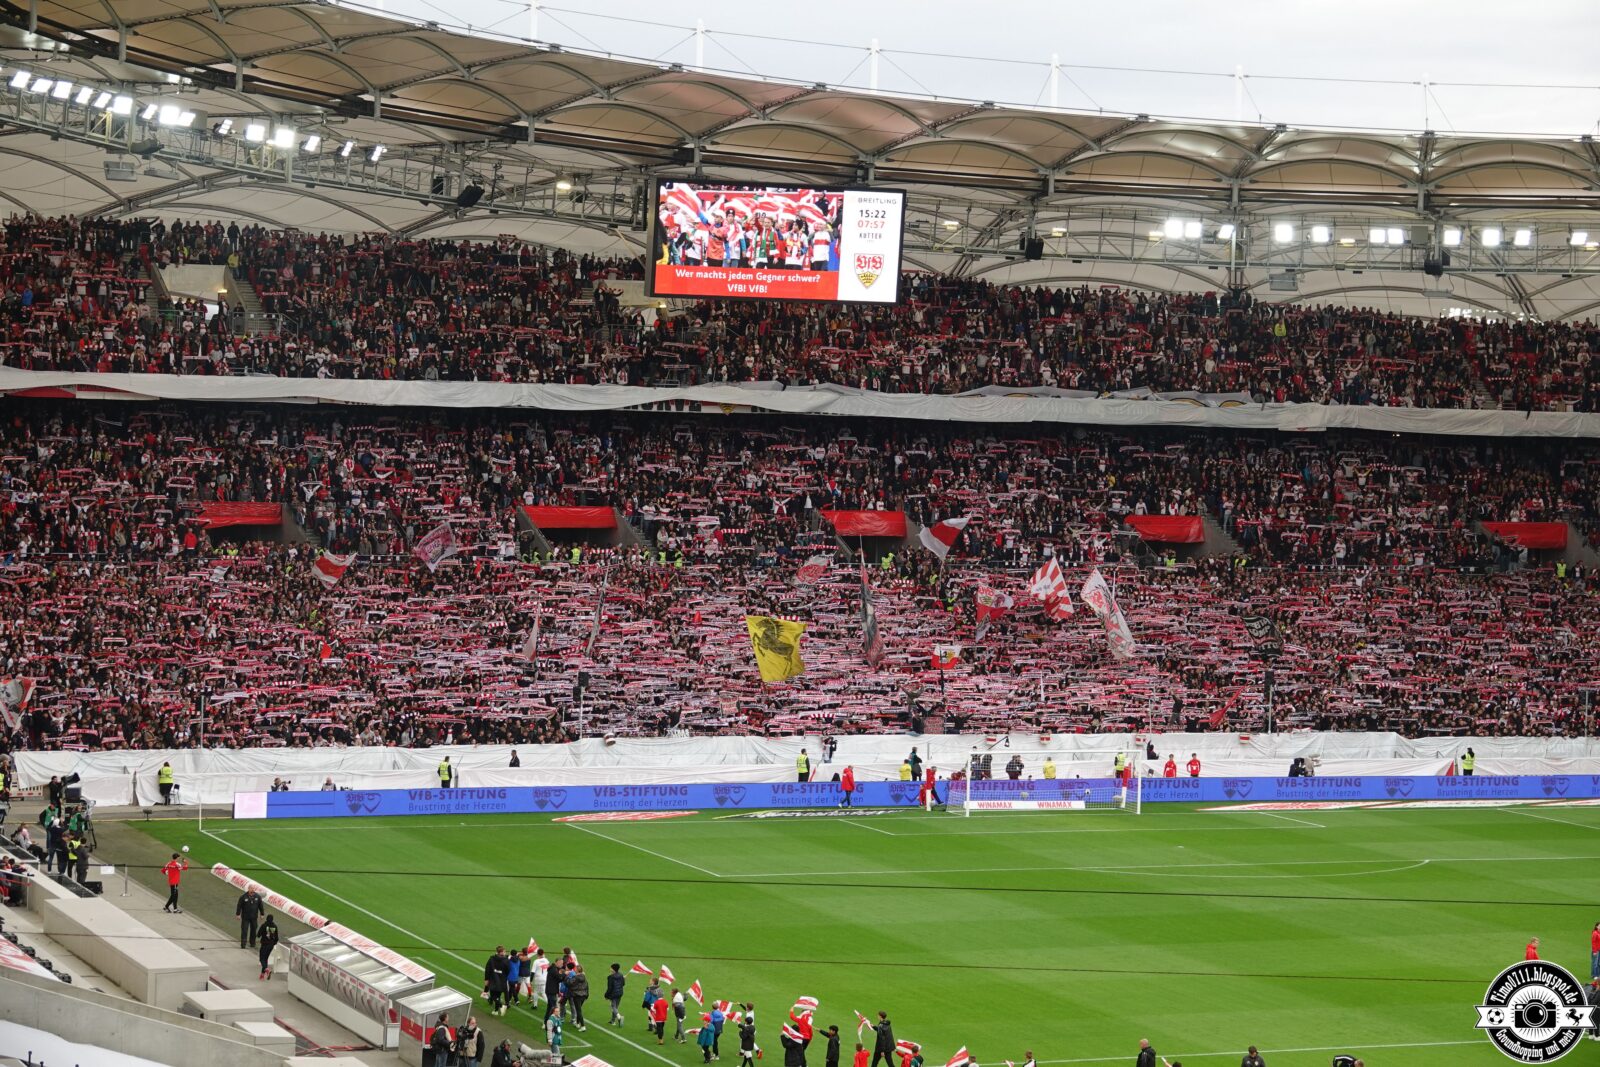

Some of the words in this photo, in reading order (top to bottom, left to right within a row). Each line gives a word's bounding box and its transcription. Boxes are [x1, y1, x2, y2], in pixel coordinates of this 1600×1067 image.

[860, 209, 886, 218] 15:22
[857, 220, 885, 229] 07:57
[675, 269, 693, 278] Wer
[696, 270, 727, 280] machts
[728, 271, 753, 281] jedem
[756, 272, 785, 283] Gegner
[787, 273, 821, 283] schwer?
[727, 283, 746, 293] VfB!
[749, 284, 768, 293] VfB!
[1113, 779, 1199, 789] VB-STIFTUNG
[1277, 777, 1361, 787] VfB-STIFTUNG
[1437, 777, 1519, 786] VfB-STIFTUNG
[593, 785, 688, 797] VfB-STIFTUNG
[772, 783, 864, 794] VfB-STIFTUG
[1437, 788, 1472, 798] Brustring
[1475, 788, 1488, 796] der
[1492, 788, 1518, 796] Herzen
[408, 789, 507, 801] VfB-STIFTUNG
[1153, 791, 1166, 799] der
[1170, 791, 1199, 799] Herzen
[1277, 789, 1313, 799] Brustring
[1316, 789, 1329, 797] der
[1335, 789, 1361, 797] Herzen
[593, 799, 635, 809] Brustring
[638, 799, 652, 807] der
[772, 795, 811, 805] Brustring
[815, 795, 828, 803] der
[977, 801, 1012, 809] WINAMAX
[409, 802, 451, 812] Brustring
[454, 802, 469, 810] der
[473, 801, 507, 810] Herzen
